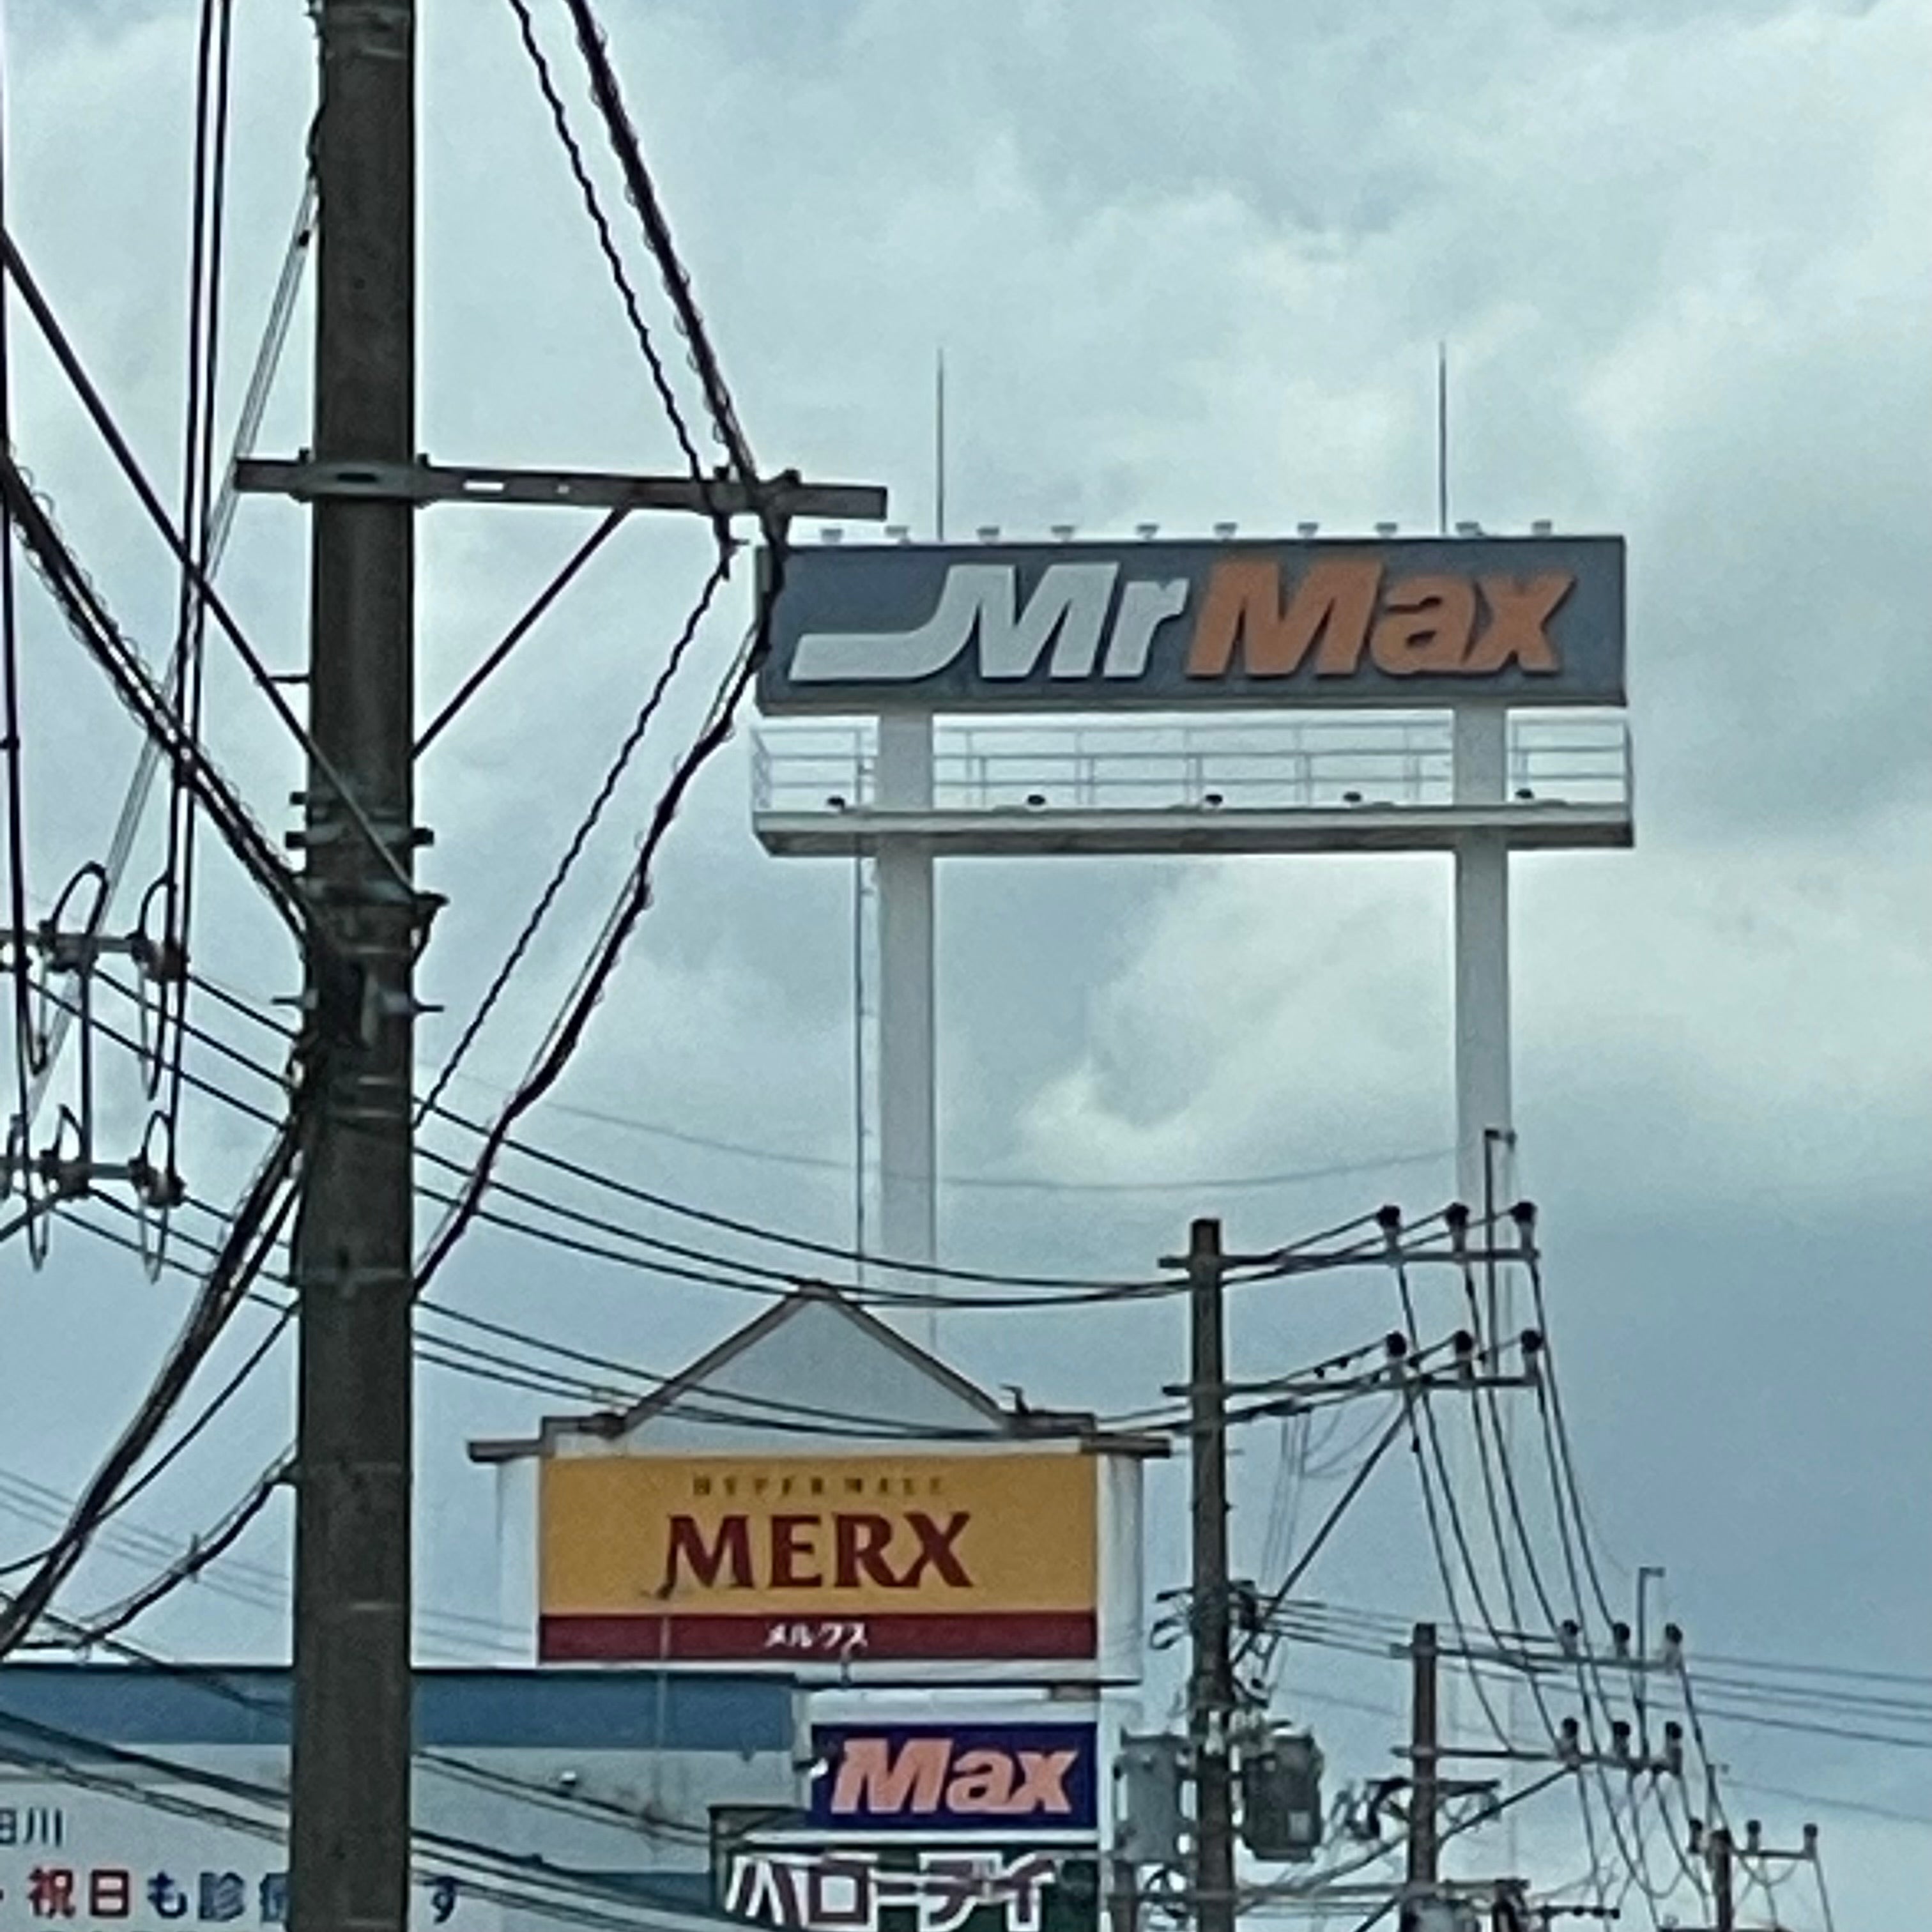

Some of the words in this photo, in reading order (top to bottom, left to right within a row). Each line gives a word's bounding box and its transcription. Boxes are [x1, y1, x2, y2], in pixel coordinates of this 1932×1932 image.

[664, 1511, 975, 1591] MERX
[765, 1621, 868, 1652] メルクス
[831, 1737, 1078, 1814] Max
